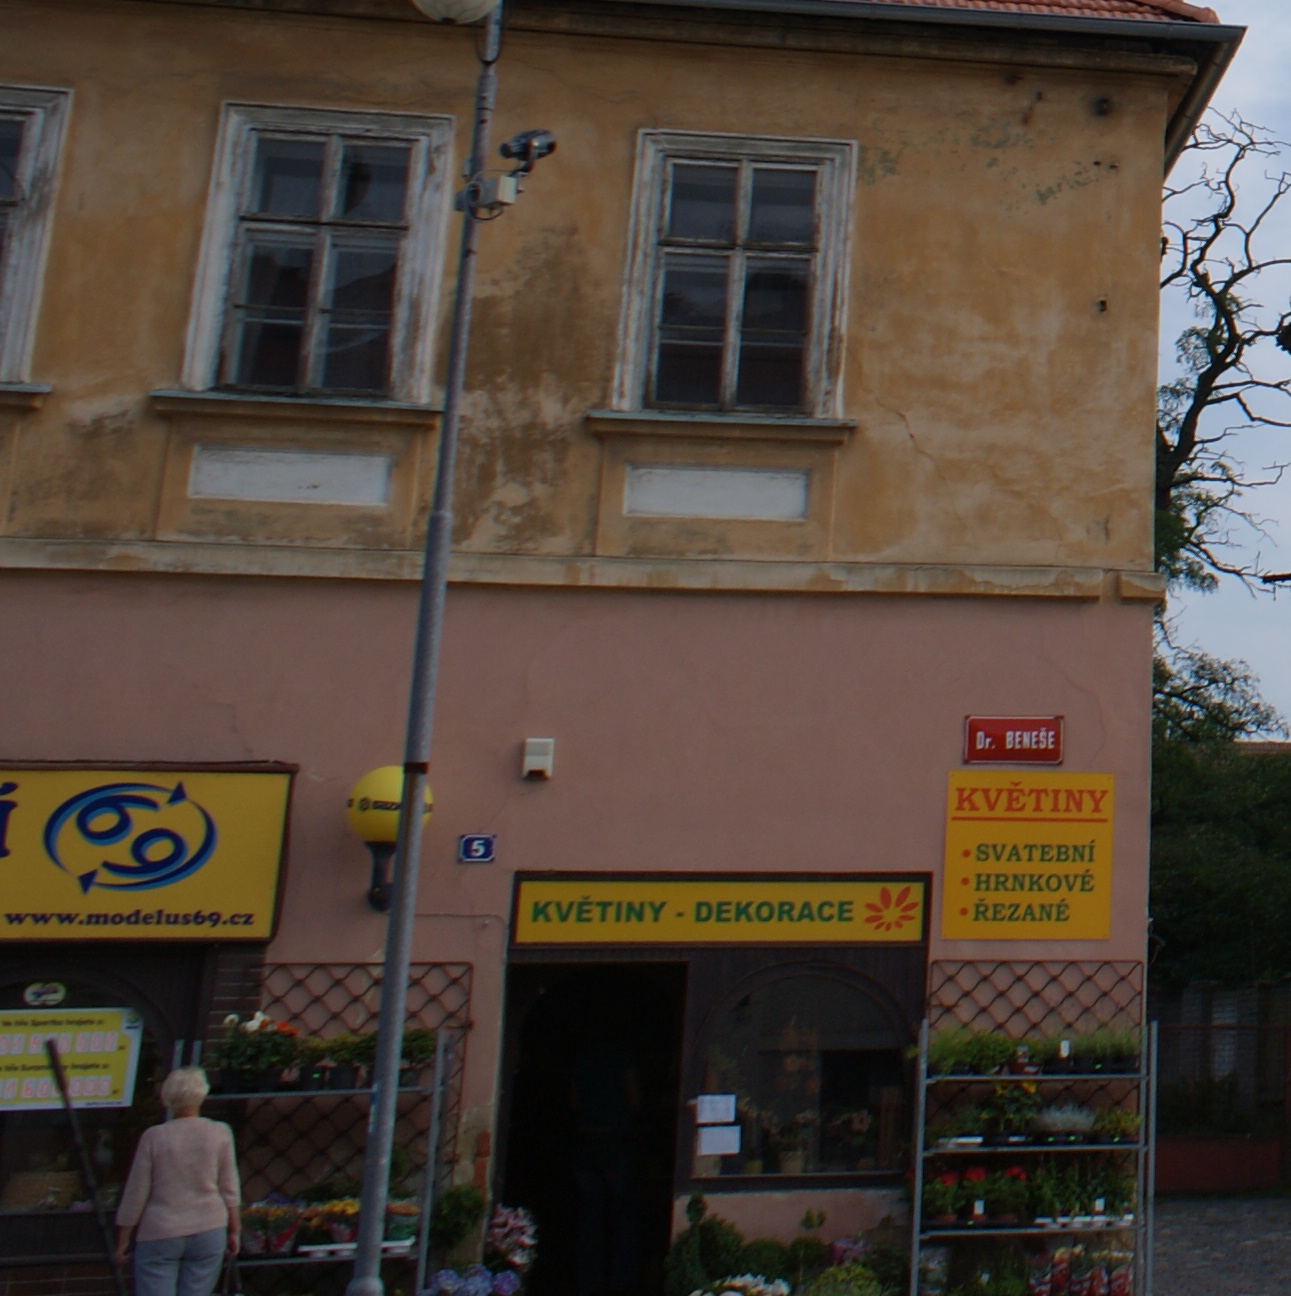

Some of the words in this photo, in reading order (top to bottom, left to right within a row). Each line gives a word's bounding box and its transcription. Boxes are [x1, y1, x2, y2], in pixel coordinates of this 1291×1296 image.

[976, 730, 996, 750] Dr.
[1005, 727, 1056, 750] BENEŠE
[954, 781, 1109, 813] KVĚTINY
[471, 840, 487, 858] 5
[975, 839, 1096, 863] SVATEBNÍ
[973, 869, 1096, 893] HRNKOVÉ
[4, 909, 255, 928] www.modelus69.cz
[532, 895, 668, 924] KVĚTINY
[694, 900, 855, 924] DEKORACE
[972, 898, 1071, 922] ŘEZANÉ
